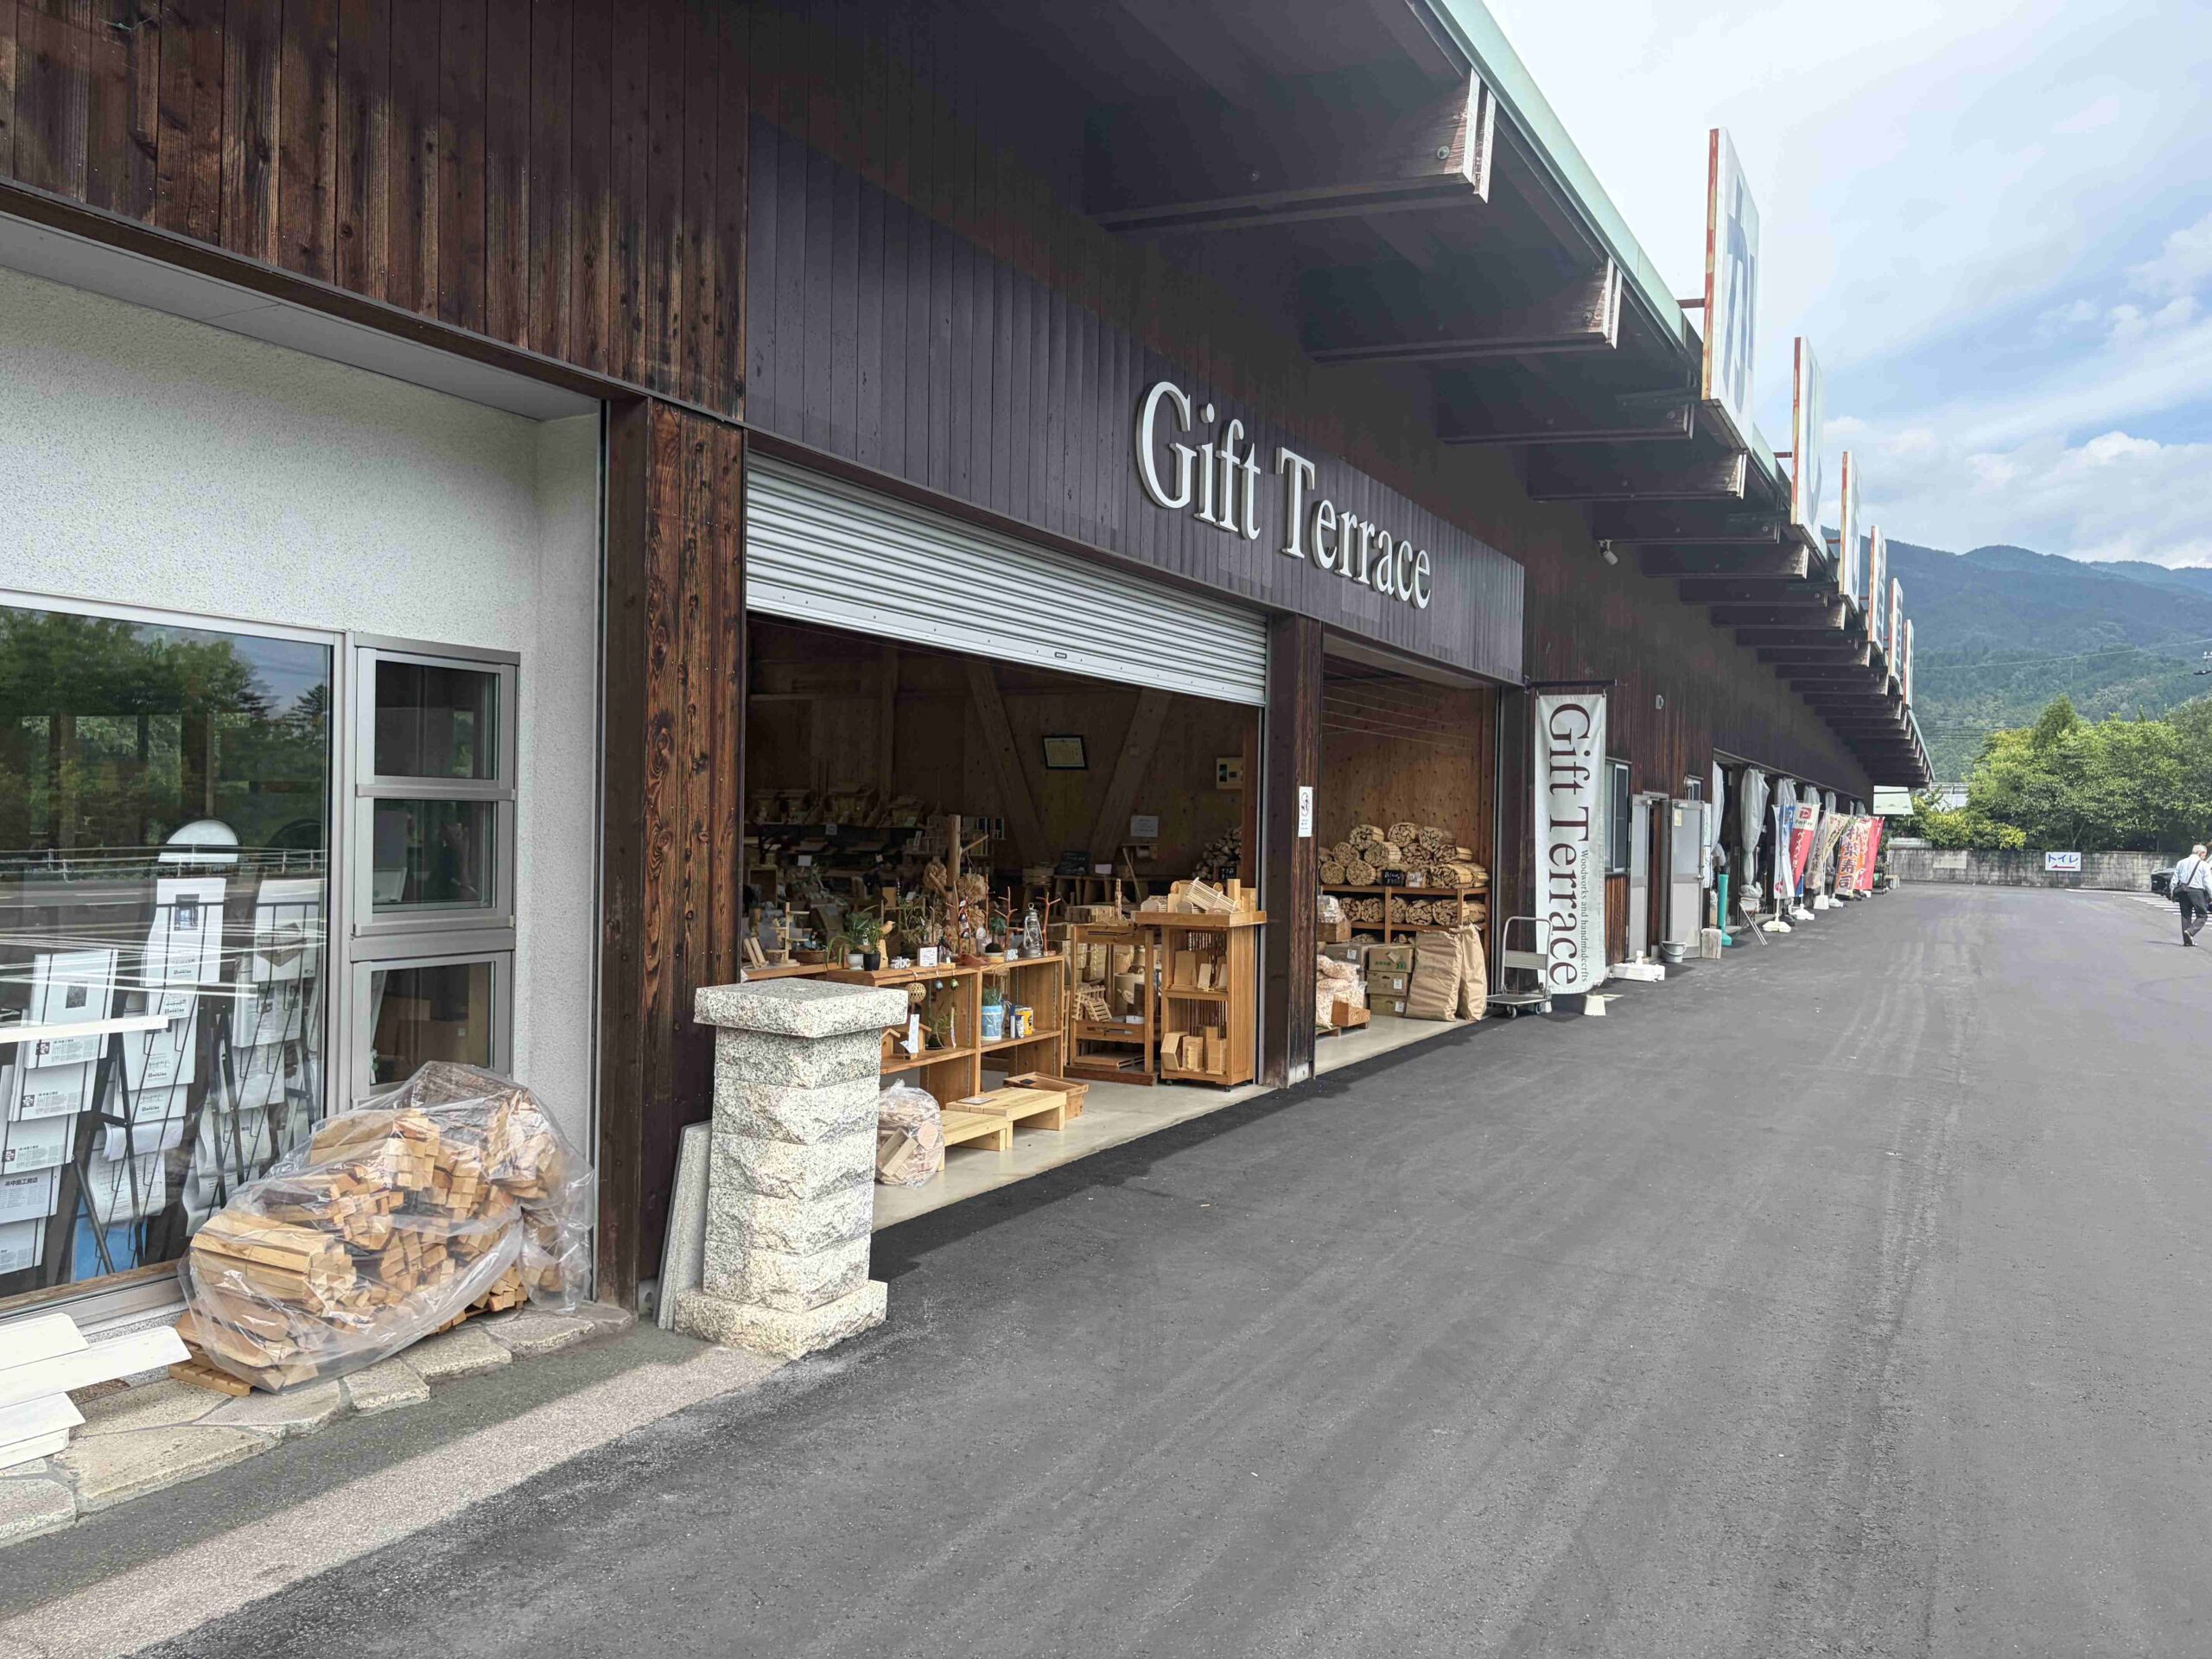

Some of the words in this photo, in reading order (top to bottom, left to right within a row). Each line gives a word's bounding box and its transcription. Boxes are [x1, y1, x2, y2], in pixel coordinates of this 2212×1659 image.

[1136, 381, 1261, 540] Gift
[1276, 447, 1430, 609] Terrace
[1549, 703, 1591, 795] Gift
[1580, 849, 1589, 899] Woodworks
[2048, 854, 2079, 863] トイレ
[1548, 806, 1589, 986] Terrace
[1580, 901, 1589, 918] and
